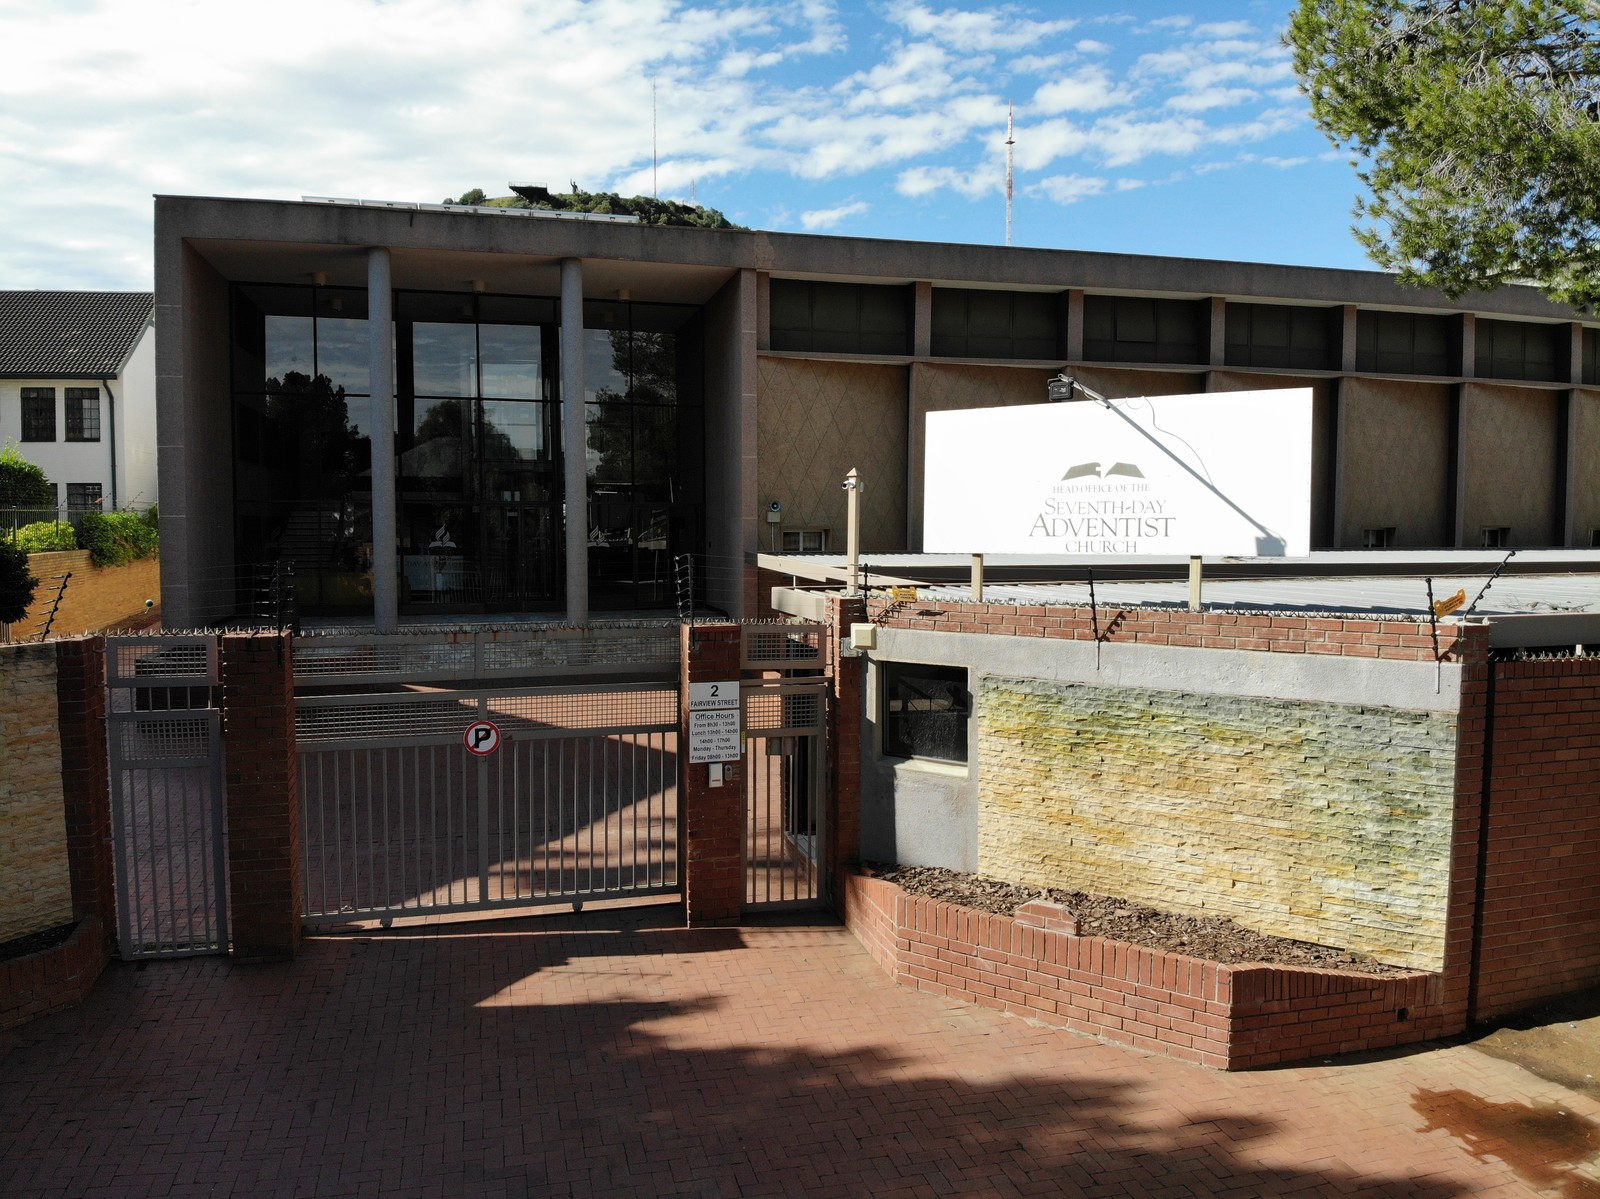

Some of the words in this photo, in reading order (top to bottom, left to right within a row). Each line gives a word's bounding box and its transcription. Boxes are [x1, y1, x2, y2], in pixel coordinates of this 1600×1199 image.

[1053, 485, 1078, 494] HEAD
[1080, 484, 1113, 493] OFFICE
[1115, 484, 1128, 492] OF
[1130, 483, 1151, 492] THE
[1044, 498, 1167, 515] SEVENTH-DAY
[1028, 513, 1176, 537] ADVENTIST
[1065, 540, 1137, 553] CHURCH
[711, 685, 719, 697] 2
[475, 728, 492, 748] P
